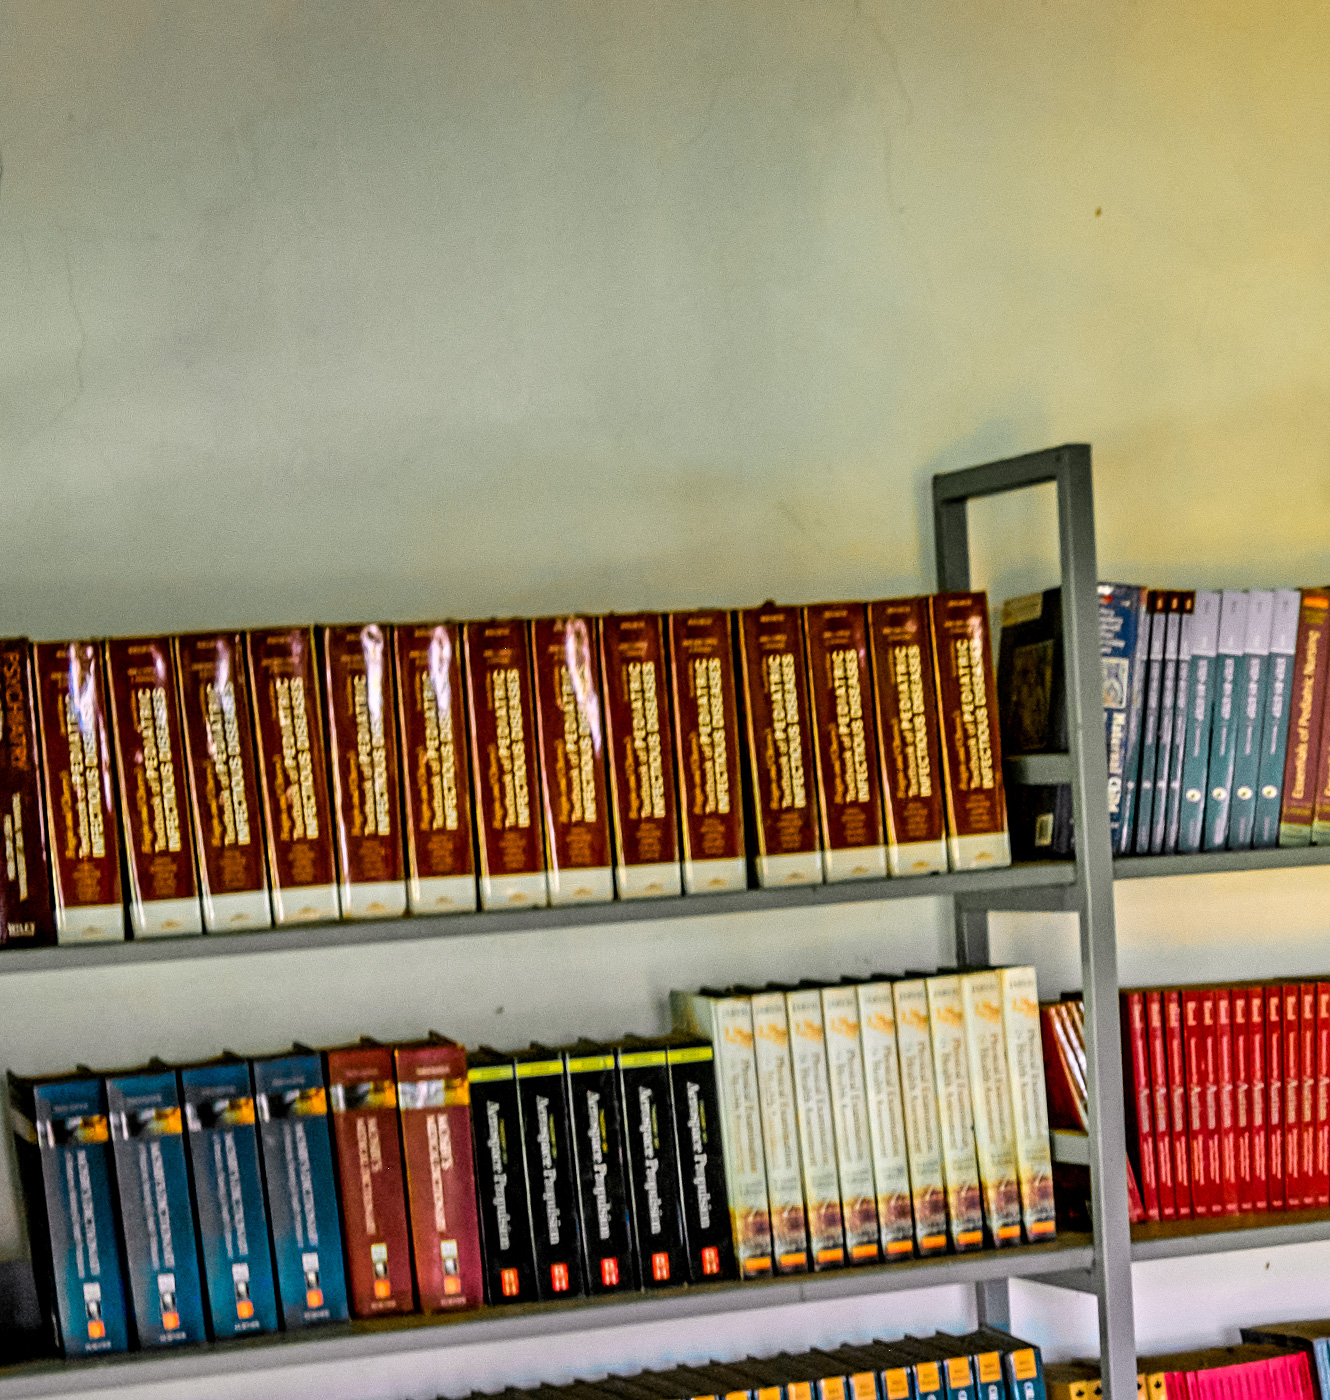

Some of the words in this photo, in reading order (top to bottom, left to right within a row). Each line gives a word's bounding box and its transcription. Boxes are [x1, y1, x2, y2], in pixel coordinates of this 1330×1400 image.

[782, 654, 800, 723] DISEASES
[845, 649, 864, 718] DISEASES
[894, 646, 913, 729] PEDIATRIC
[908, 645, 926, 713] DISEASES
[1303, 631, 1321, 675] Nursing
[628, 661, 647, 749] PEDIATRIC
[641, 661, 660, 732] DISEASES
[694, 657, 713, 744] PEDIATRIC
[706, 658, 724, 728] DISEASES
[768, 655, 788, 739] PEDIATRIC
[831, 650, 851, 734] PEDIATRIC
[1297, 677, 1314, 726] Pediatric
[714, 729, 730, 813] INFECTIOUS
[789, 725, 807, 808] INFECTIOUS
[854, 720, 871, 802] INFECTIOUS
[916, 715, 933, 797] INFECTIOUS
[1291, 744, 1308, 799] Essentials
[1296, 727, 1309, 742] of
[649, 734, 667, 818] INFECTIOUS
[486, 1101, 506, 1173] Aerospace
[536, 1096, 554, 1168] Aerospace
[586, 1091, 604, 1162] Aerospace
[638, 1086, 656, 1157] Aerospace
[686, 1082, 704, 1153] Aerospace
[493, 1174, 512, 1249] Propulsion
[542, 1169, 561, 1245] Propulsion
[592, 1164, 611, 1239] Propulsion
[645, 1158, 662, 1234] Propulsion
[693, 1154, 711, 1228] Propulsion
